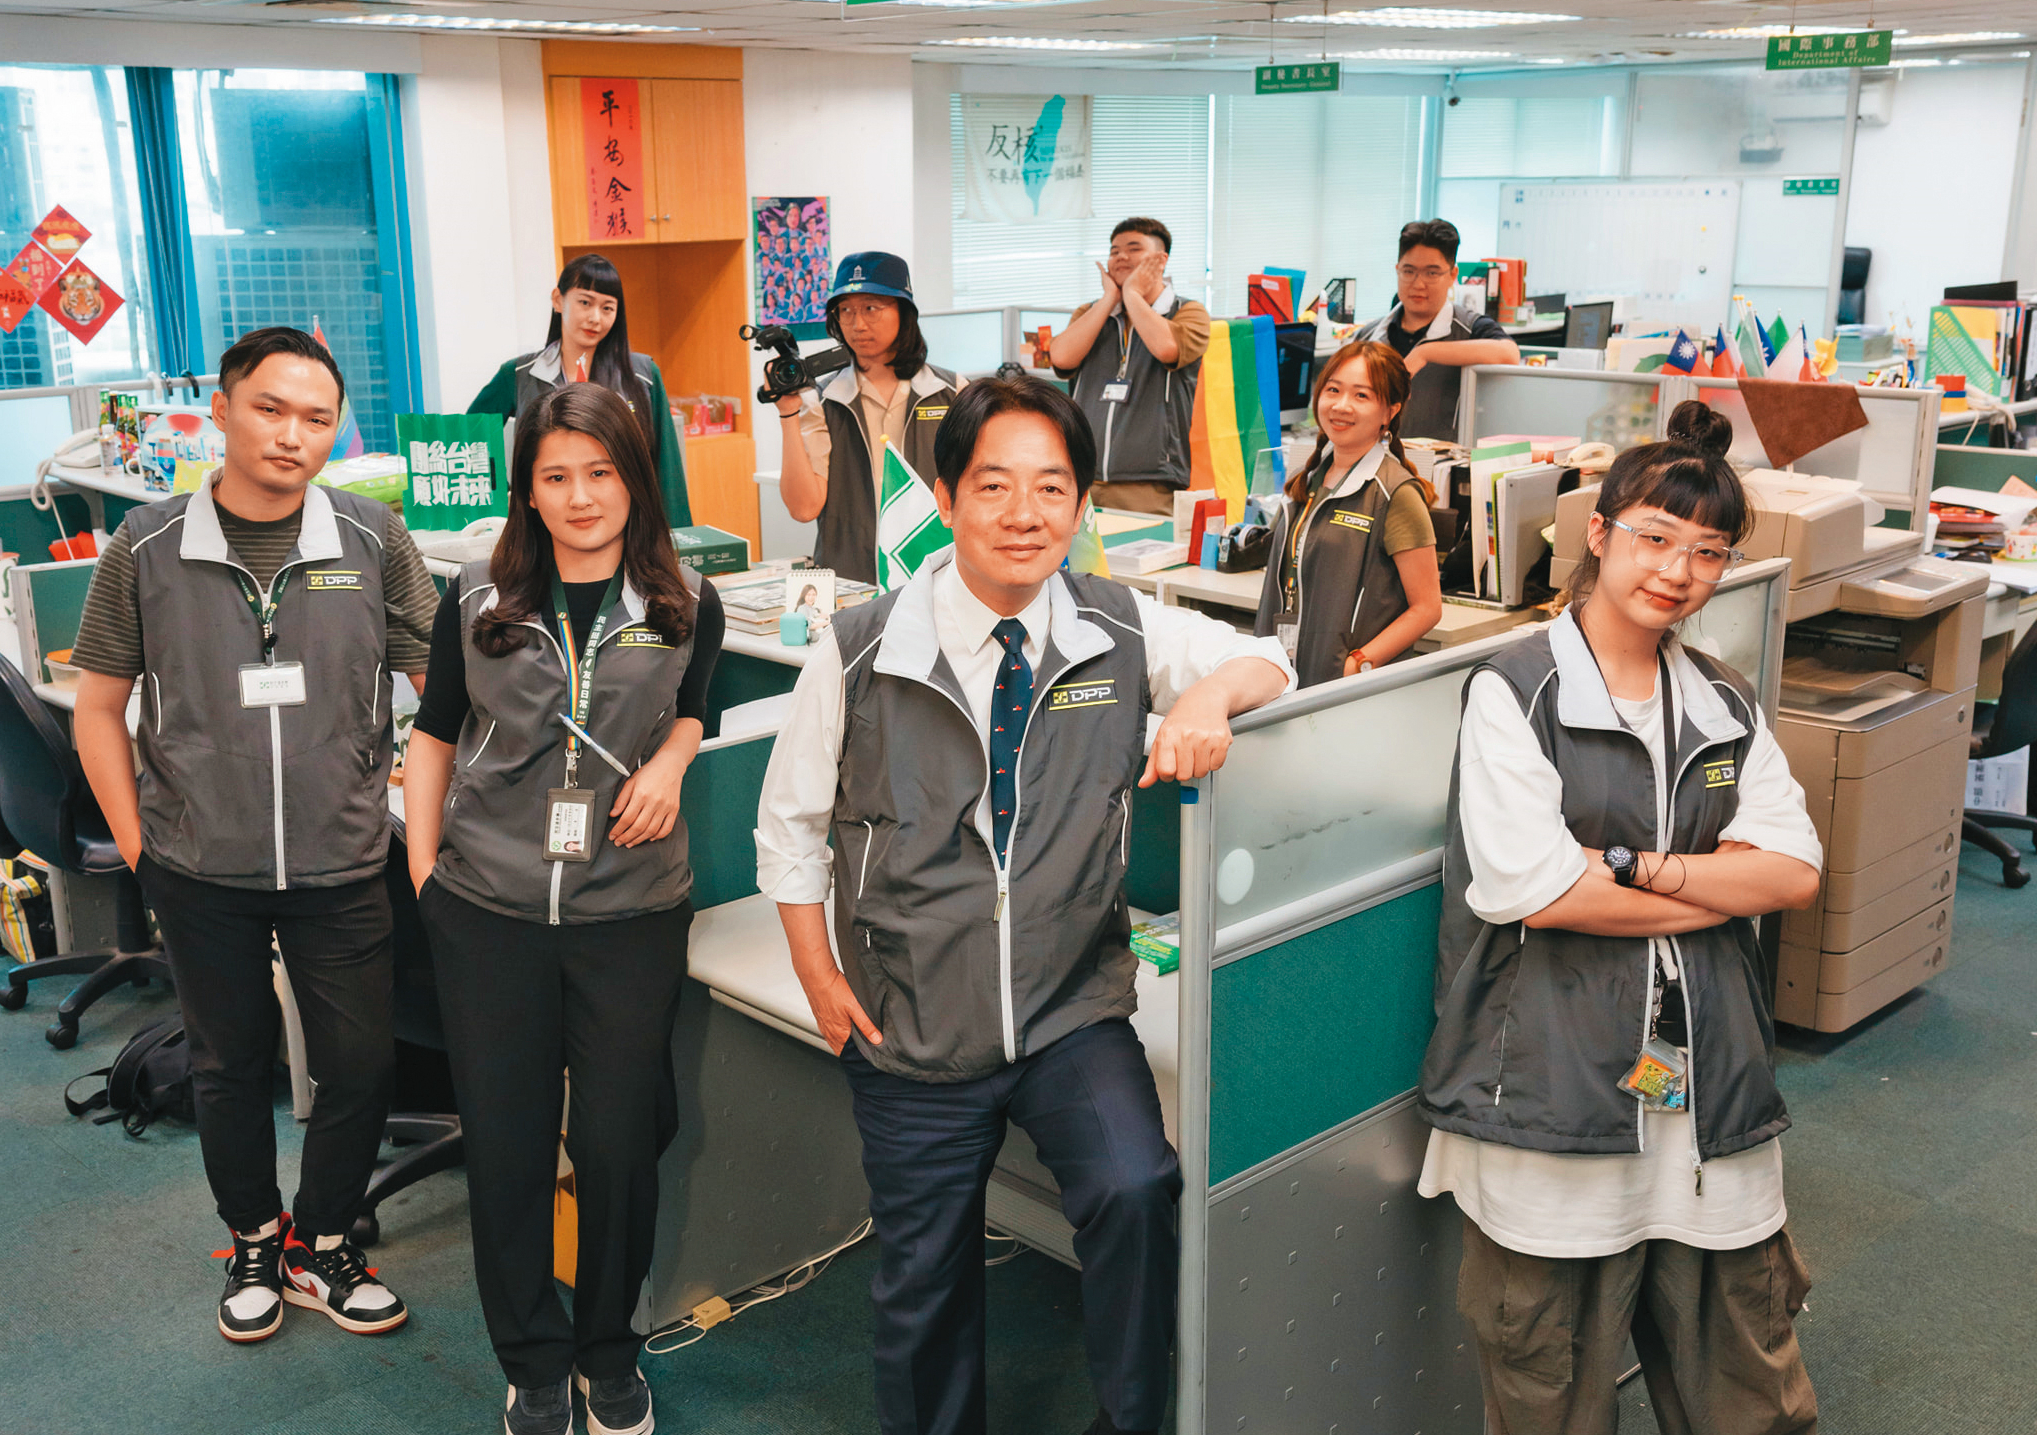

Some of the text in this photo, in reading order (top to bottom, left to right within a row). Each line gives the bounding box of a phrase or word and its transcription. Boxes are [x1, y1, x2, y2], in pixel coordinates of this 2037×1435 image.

[1778, 34, 1880, 52] 國際事務部
[1792, 51, 1845, 59] Department
[1778, 58, 1838, 66] International
[985, 125, 1041, 166] 反核
[1343, 515, 1370, 527] DPP
[323, 575, 358, 585] DPP
[1069, 686, 1111, 702] DPP
